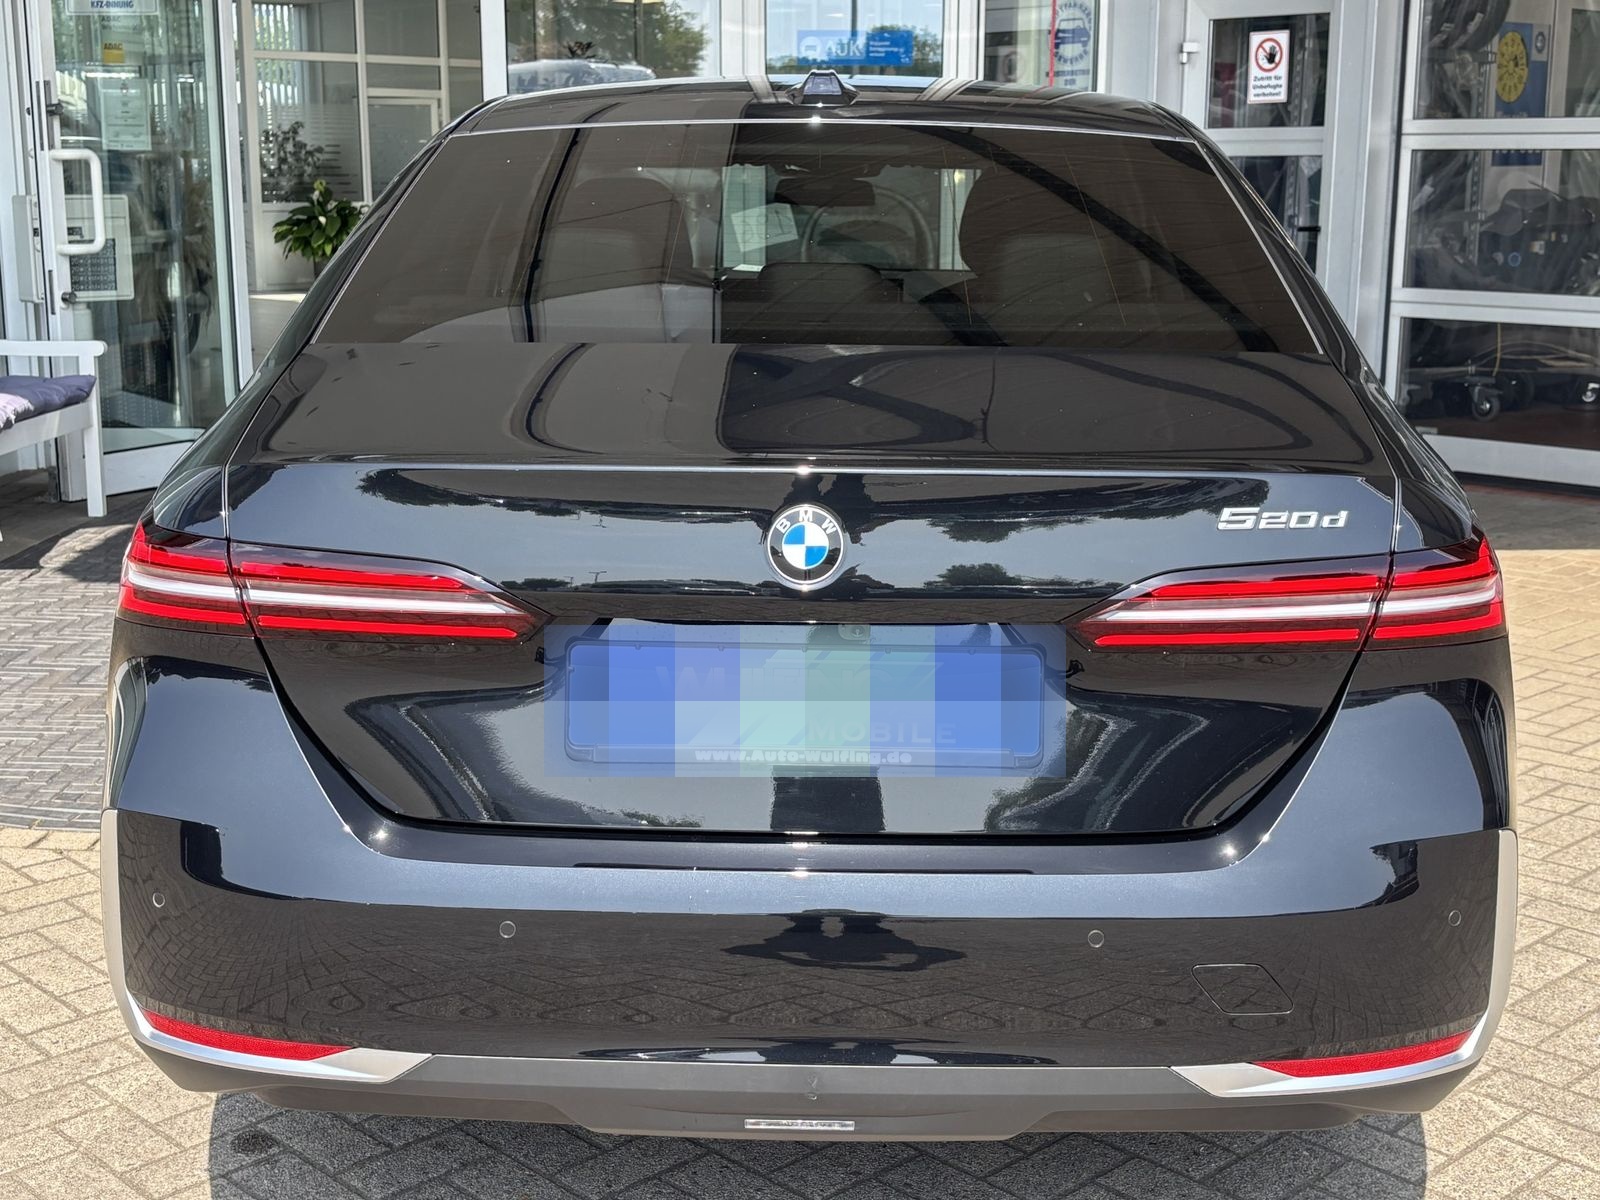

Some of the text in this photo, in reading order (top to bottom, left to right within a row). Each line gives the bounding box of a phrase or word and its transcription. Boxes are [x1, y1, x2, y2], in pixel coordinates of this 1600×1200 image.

[775, 510, 837, 535] BMW
[1217, 507, 1349, 530] 520d
[807, 716, 957, 744] MOBILE
